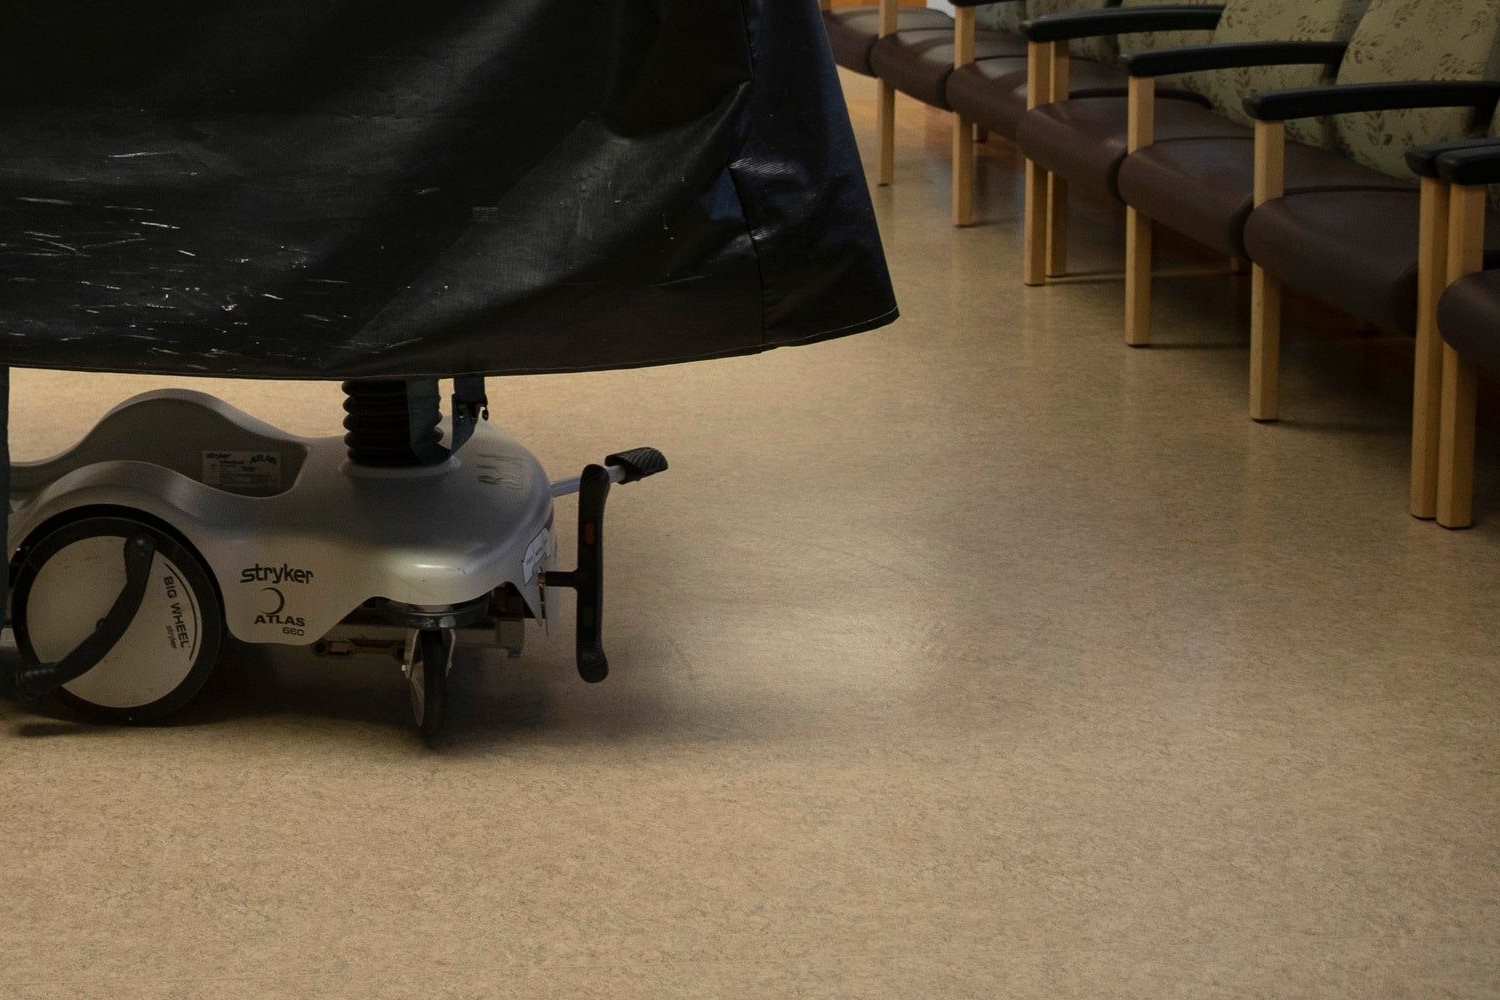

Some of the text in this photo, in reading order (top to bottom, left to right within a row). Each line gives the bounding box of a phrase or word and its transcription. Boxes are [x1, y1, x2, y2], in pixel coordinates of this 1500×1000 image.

[240, 563, 314, 584] stryker
[163, 576, 188, 648] BIG WHEEL
[254, 614, 305, 627] ATLAS
